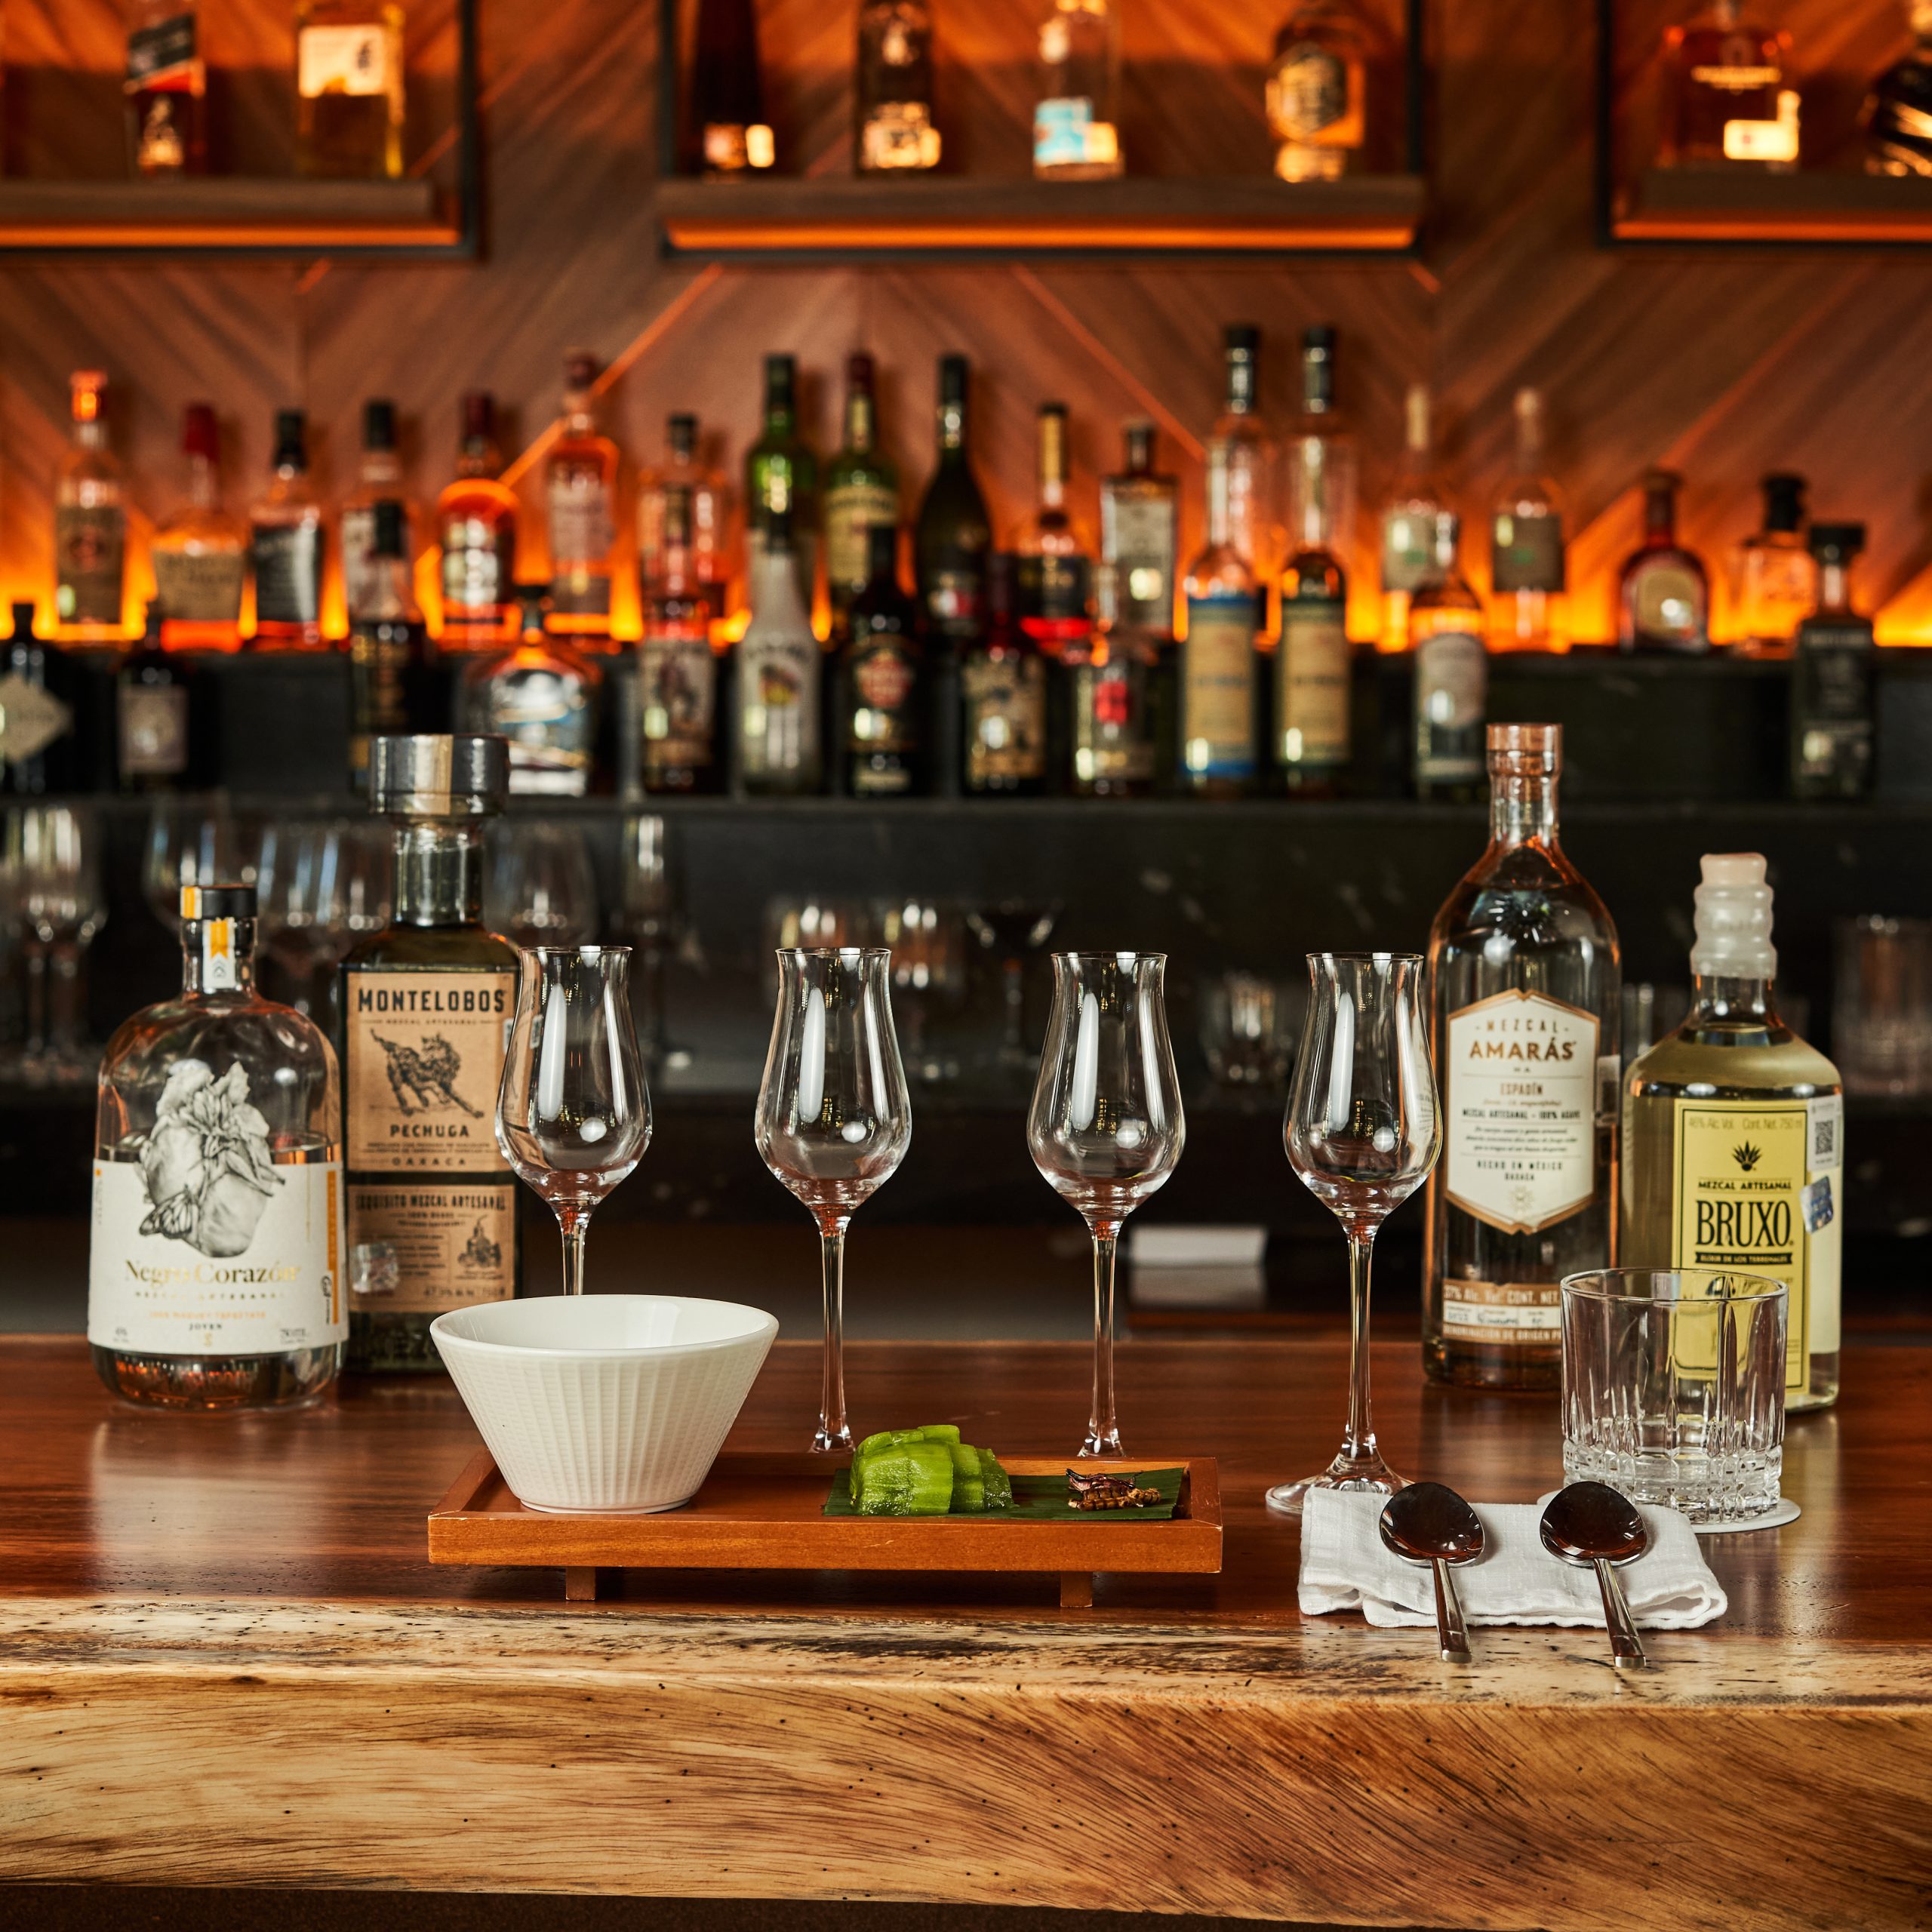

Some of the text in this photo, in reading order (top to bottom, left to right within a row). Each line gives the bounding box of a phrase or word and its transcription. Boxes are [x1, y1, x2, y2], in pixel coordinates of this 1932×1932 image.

[358, 989, 505, 1012] MONTELOBOS
[1487, 1020, 1558, 1033] MEZCAL
[1469, 1037, 1574, 1061] AMARÁS
[390, 1124, 470, 1137] PECHUGA
[1698, 1181, 1792, 1190] MEZCAL ARTESANAL
[1695, 1200, 1791, 1247] BRUXO
[126, 1260, 298, 1287] Negro Corazón
